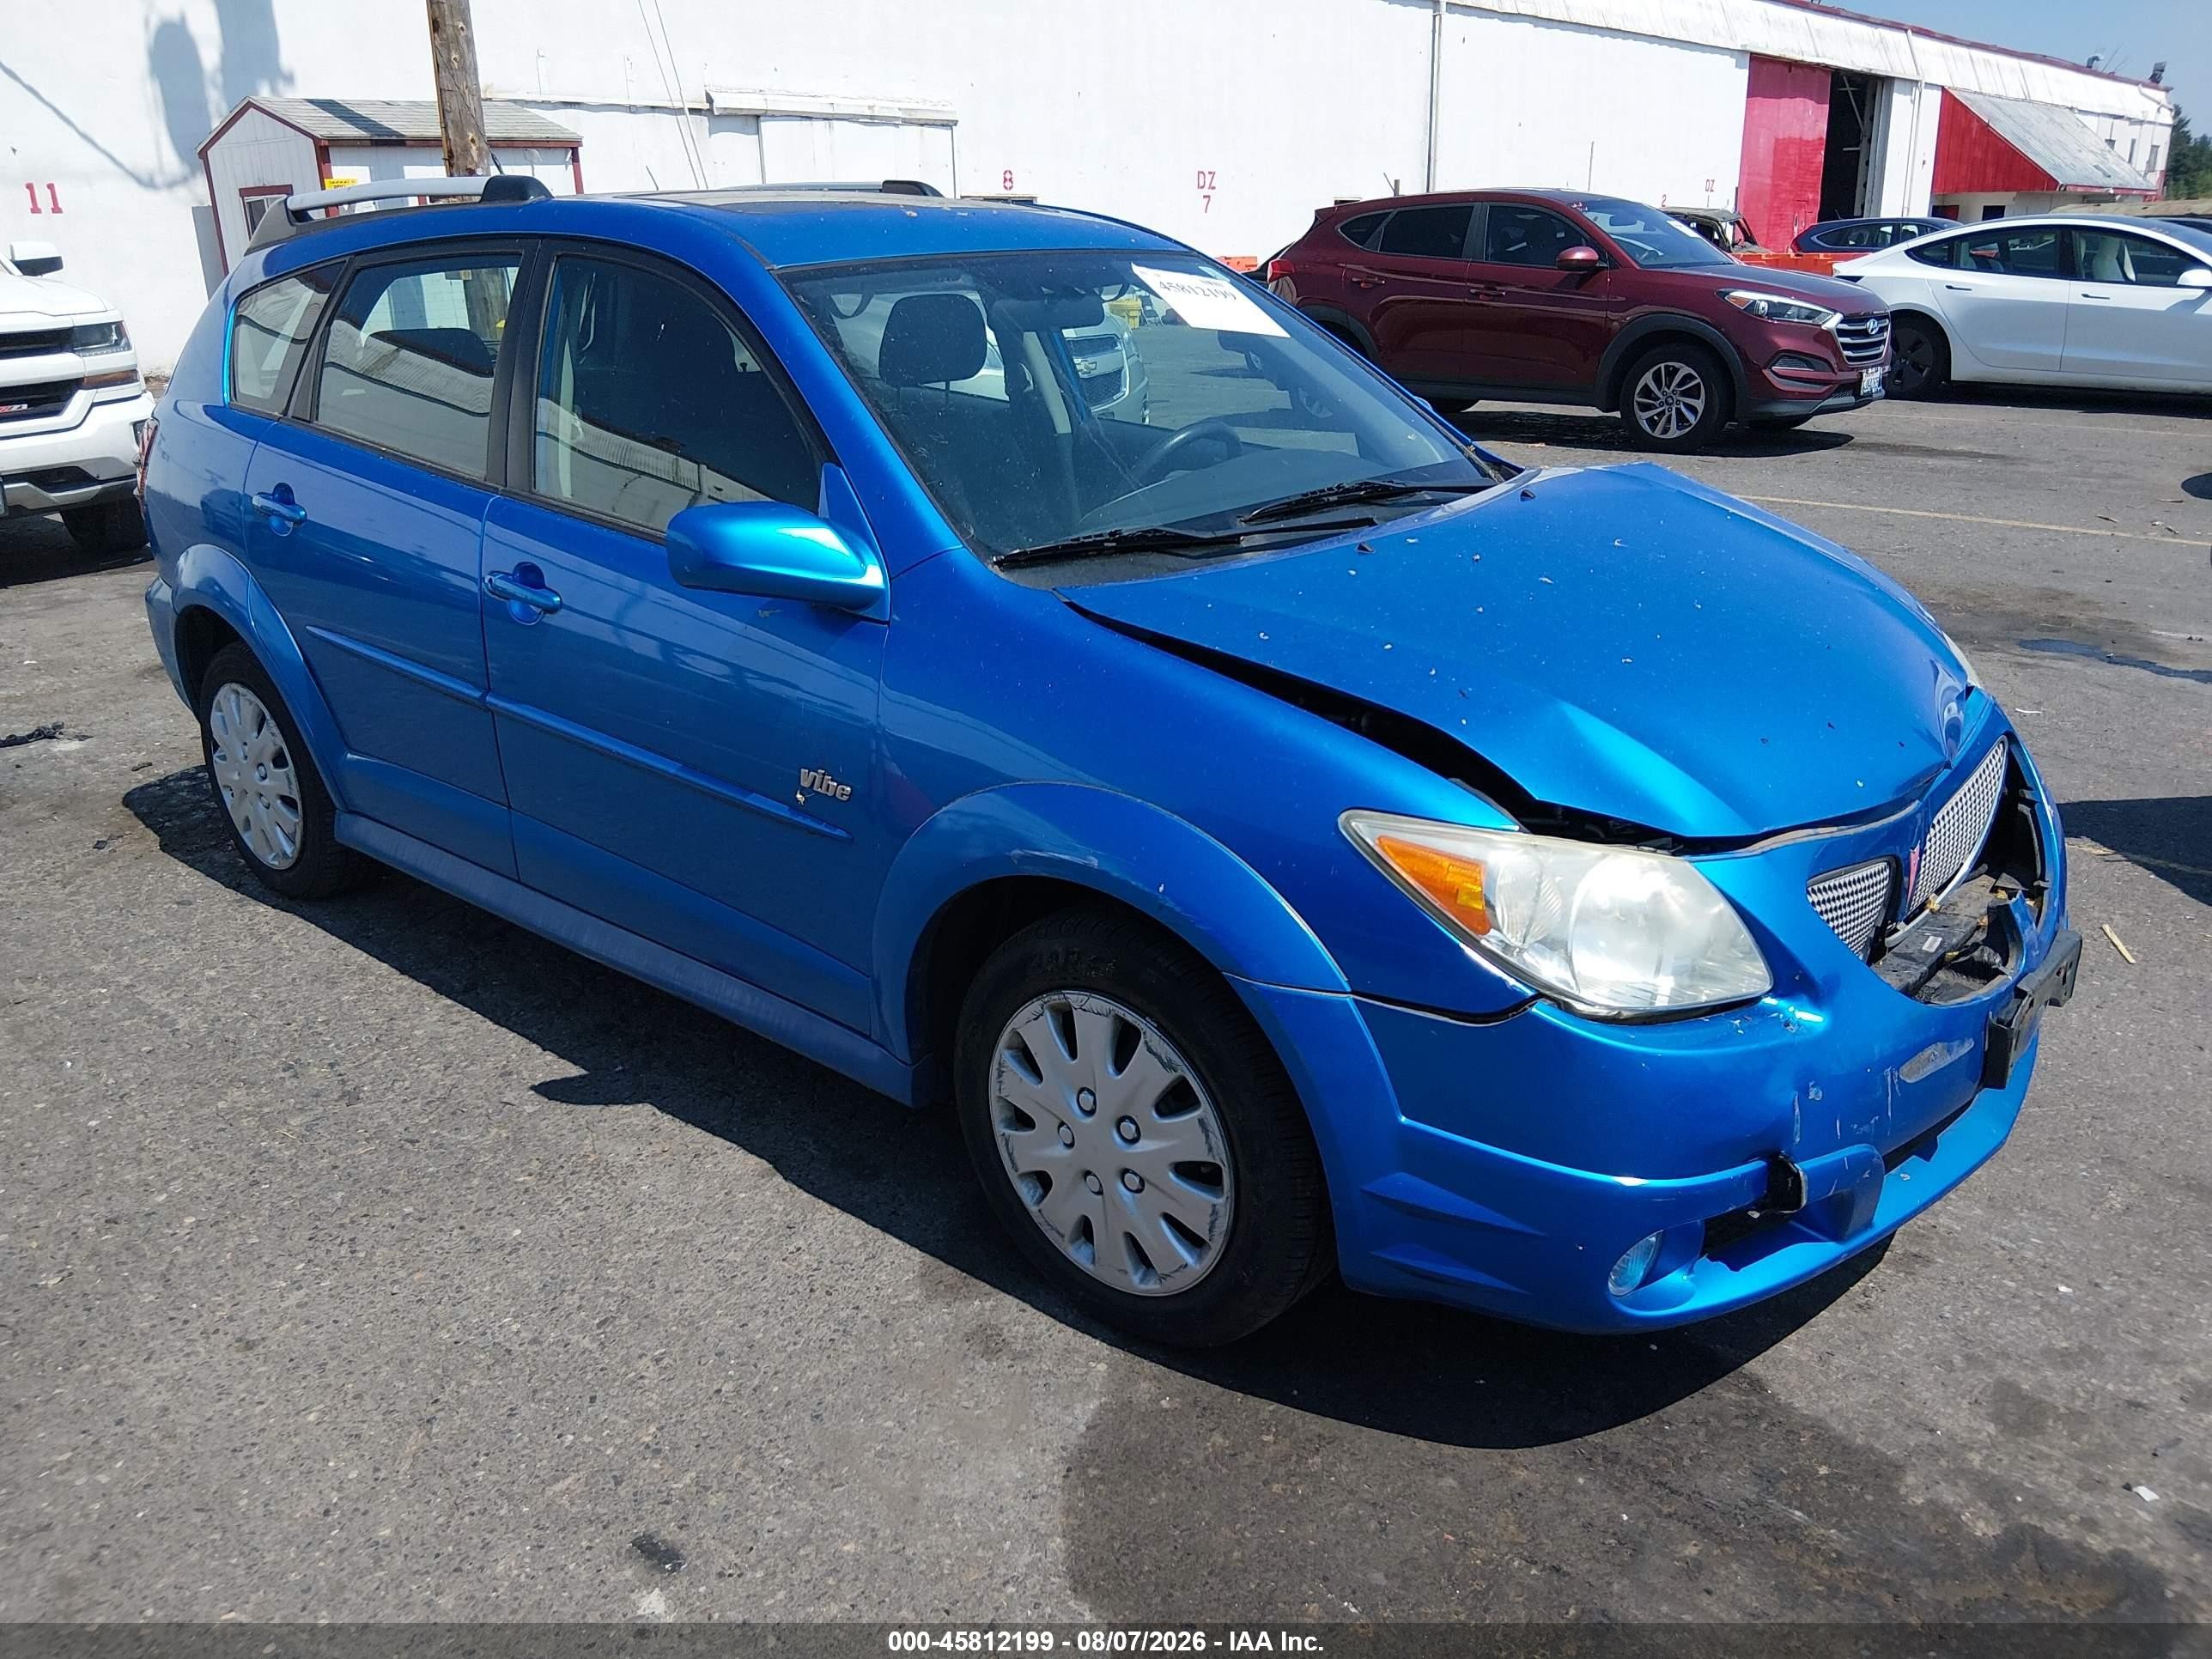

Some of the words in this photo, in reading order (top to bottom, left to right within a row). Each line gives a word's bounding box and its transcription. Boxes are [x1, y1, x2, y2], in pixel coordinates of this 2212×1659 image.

[1002, 169, 1014, 191] 8
[1197, 170, 1217, 191] DZ
[25, 182, 64, 214] 11
[1202, 194, 1212, 214] 7
[1661, 193, 1668, 208] 2
[1158, 280, 1237, 301] 45812199
[799, 768, 853, 801] vibe
